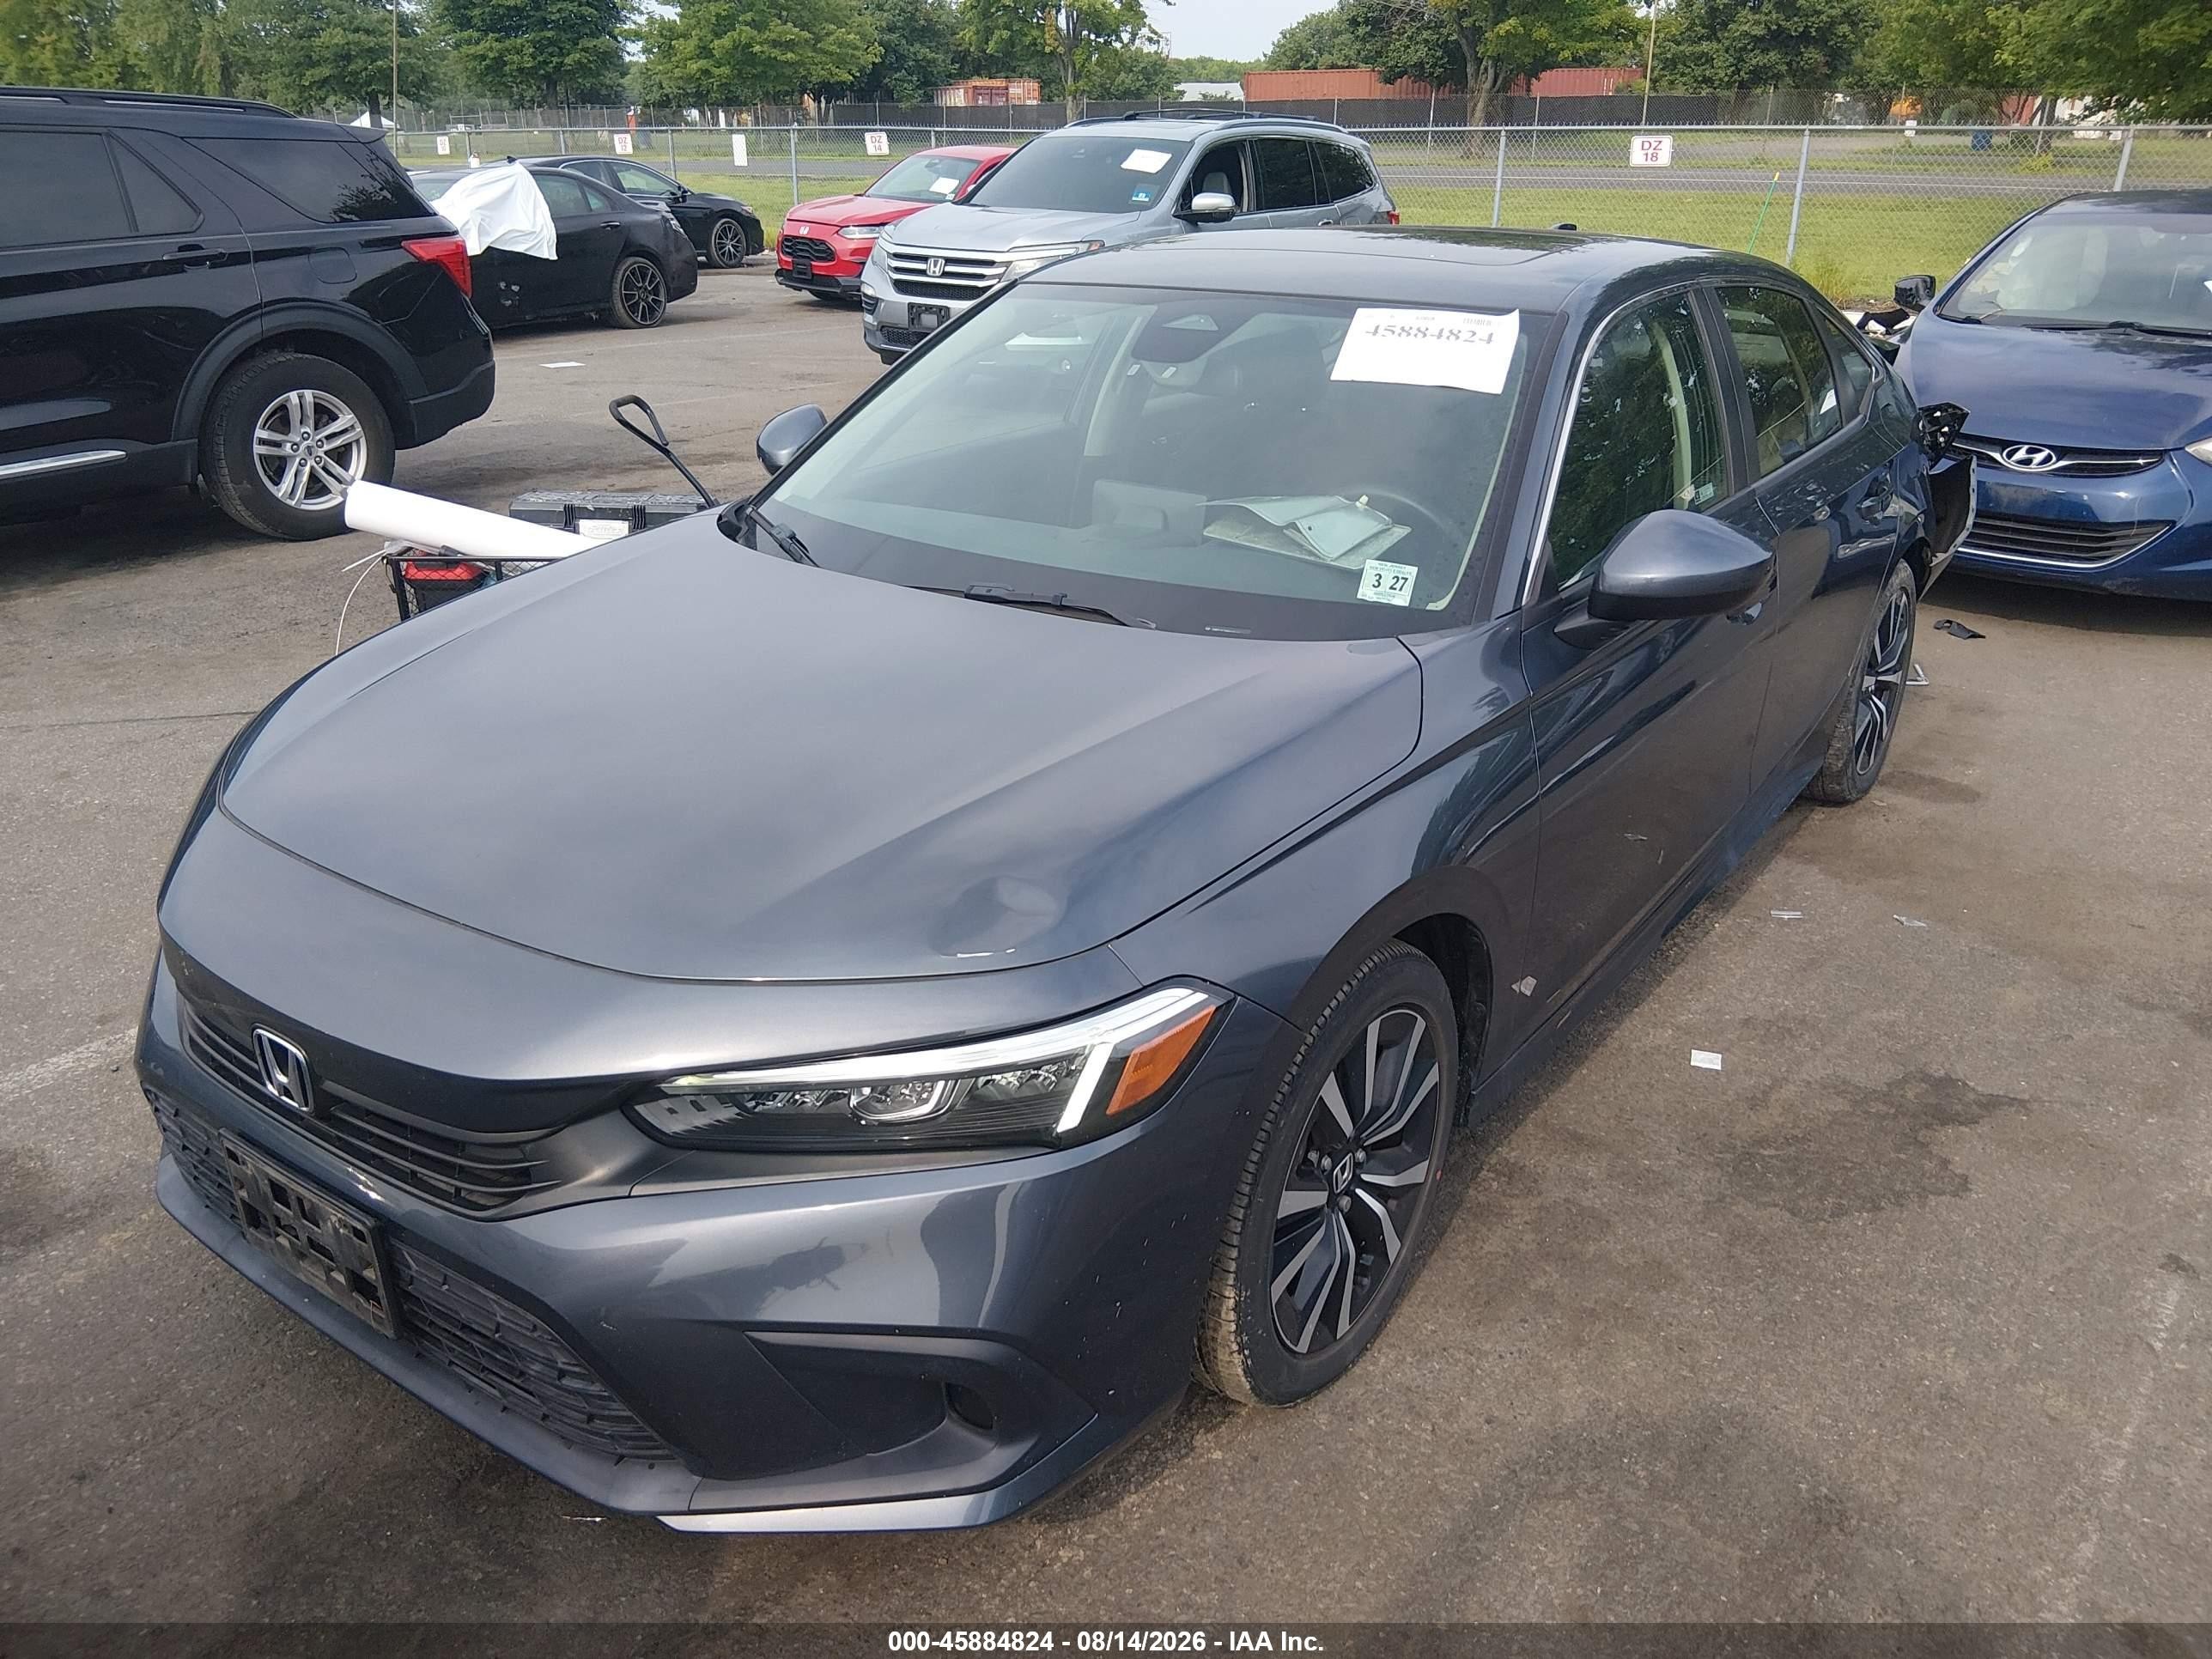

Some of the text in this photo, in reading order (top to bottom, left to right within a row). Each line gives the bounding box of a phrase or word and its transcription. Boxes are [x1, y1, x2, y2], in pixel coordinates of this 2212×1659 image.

[870, 135, 883, 144] DZ
[872, 143, 883, 152] 14
[1641, 140, 1662, 151] DZ
[1643, 151, 1659, 162] 18
[1365, 324, 1494, 344] 45884824
[1371, 573, 1409, 592] 3 27
